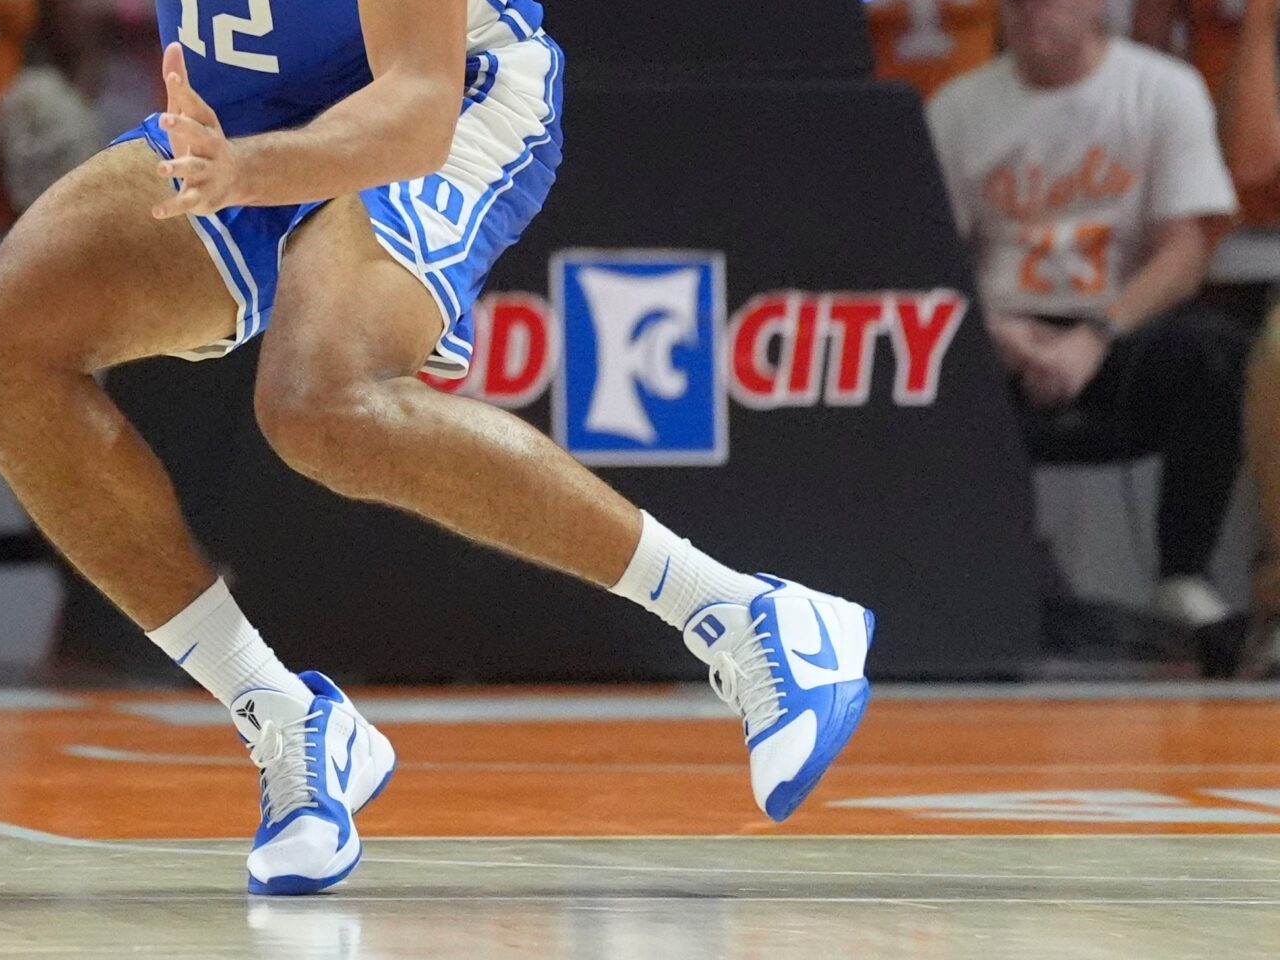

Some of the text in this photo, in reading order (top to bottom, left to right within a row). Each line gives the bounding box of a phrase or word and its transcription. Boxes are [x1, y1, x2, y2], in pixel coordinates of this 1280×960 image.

[415, 172, 464, 226] D
[727, 289, 965, 408] CITY
[691, 613, 726, 648] D
